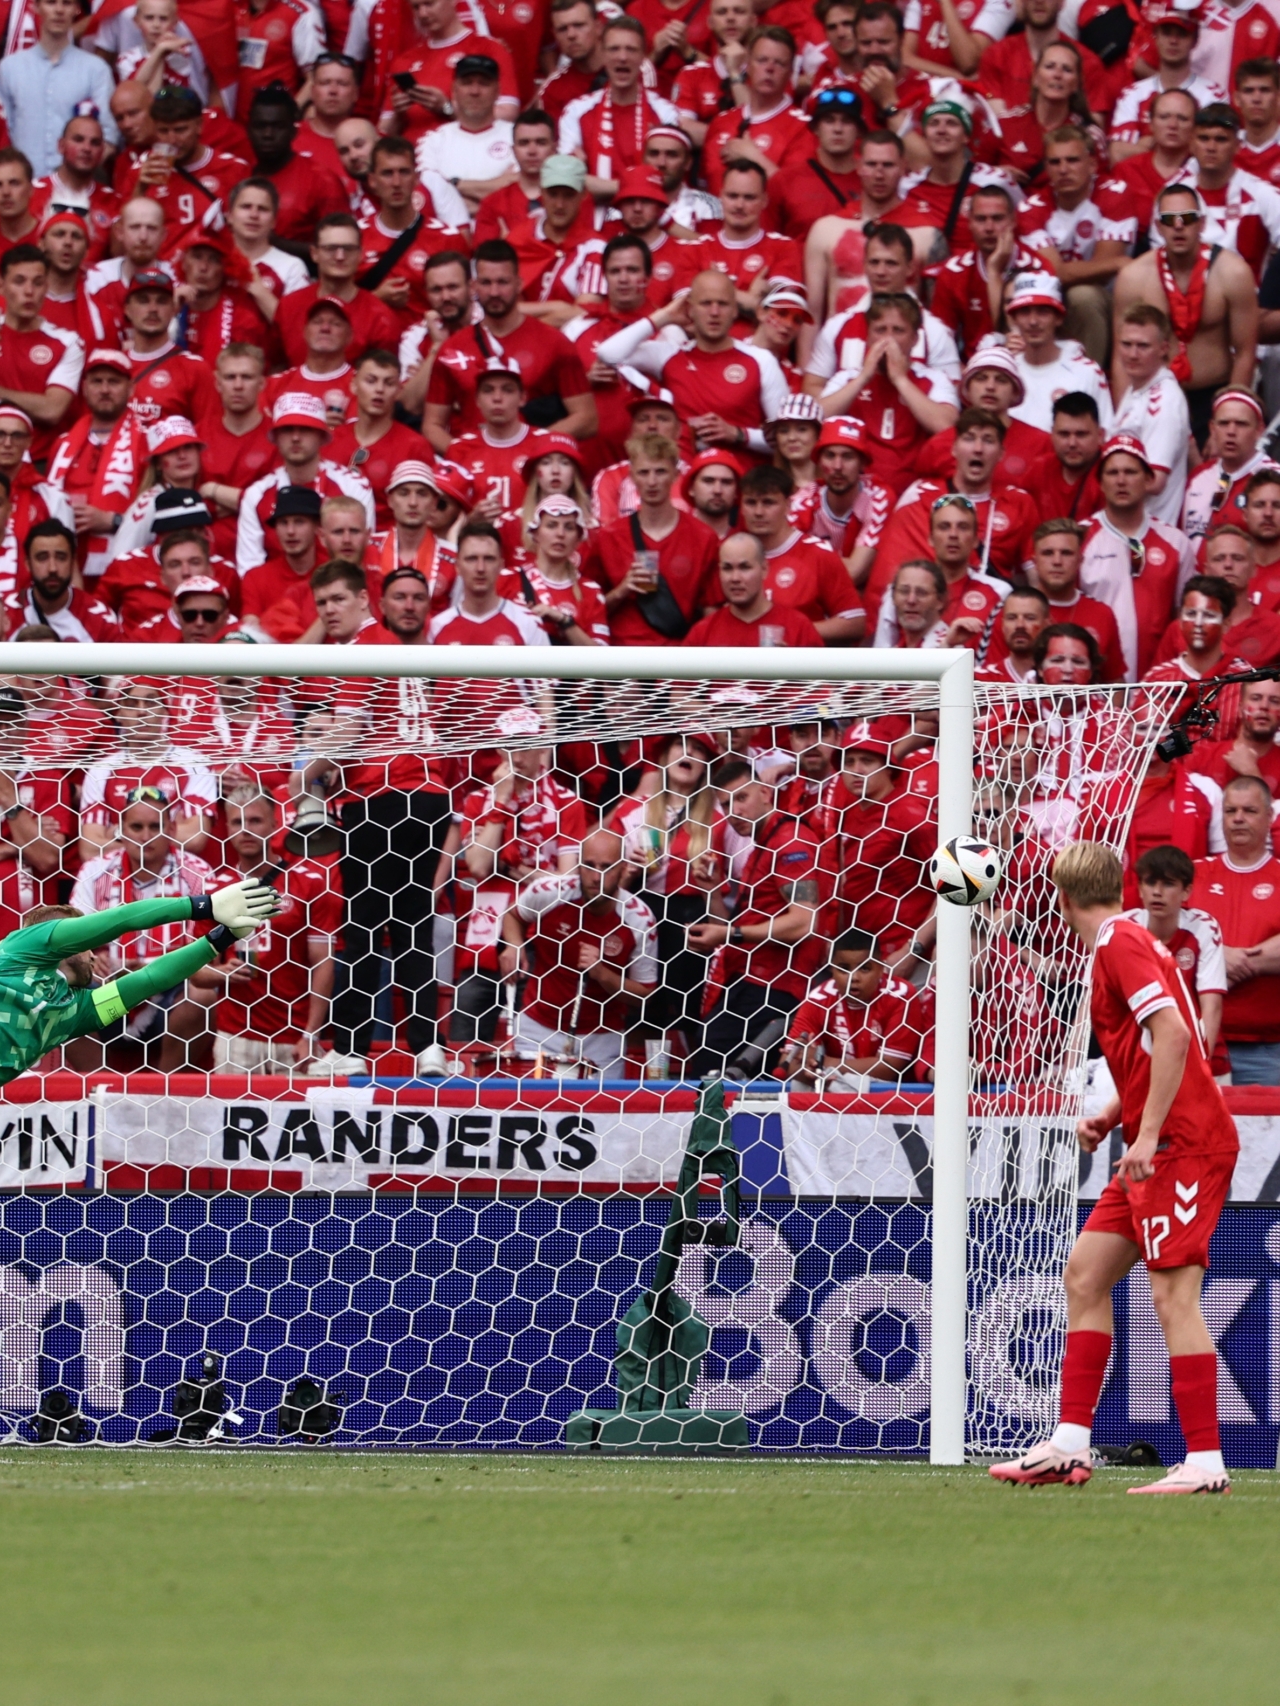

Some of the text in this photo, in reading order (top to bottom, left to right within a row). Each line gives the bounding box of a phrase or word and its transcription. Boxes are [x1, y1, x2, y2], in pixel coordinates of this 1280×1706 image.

[178, 194, 195, 224] 9
[486, 476, 511, 508] 21
[222, 1106, 598, 1171] RANDERS
[1141, 1215, 1170, 1261] 17
